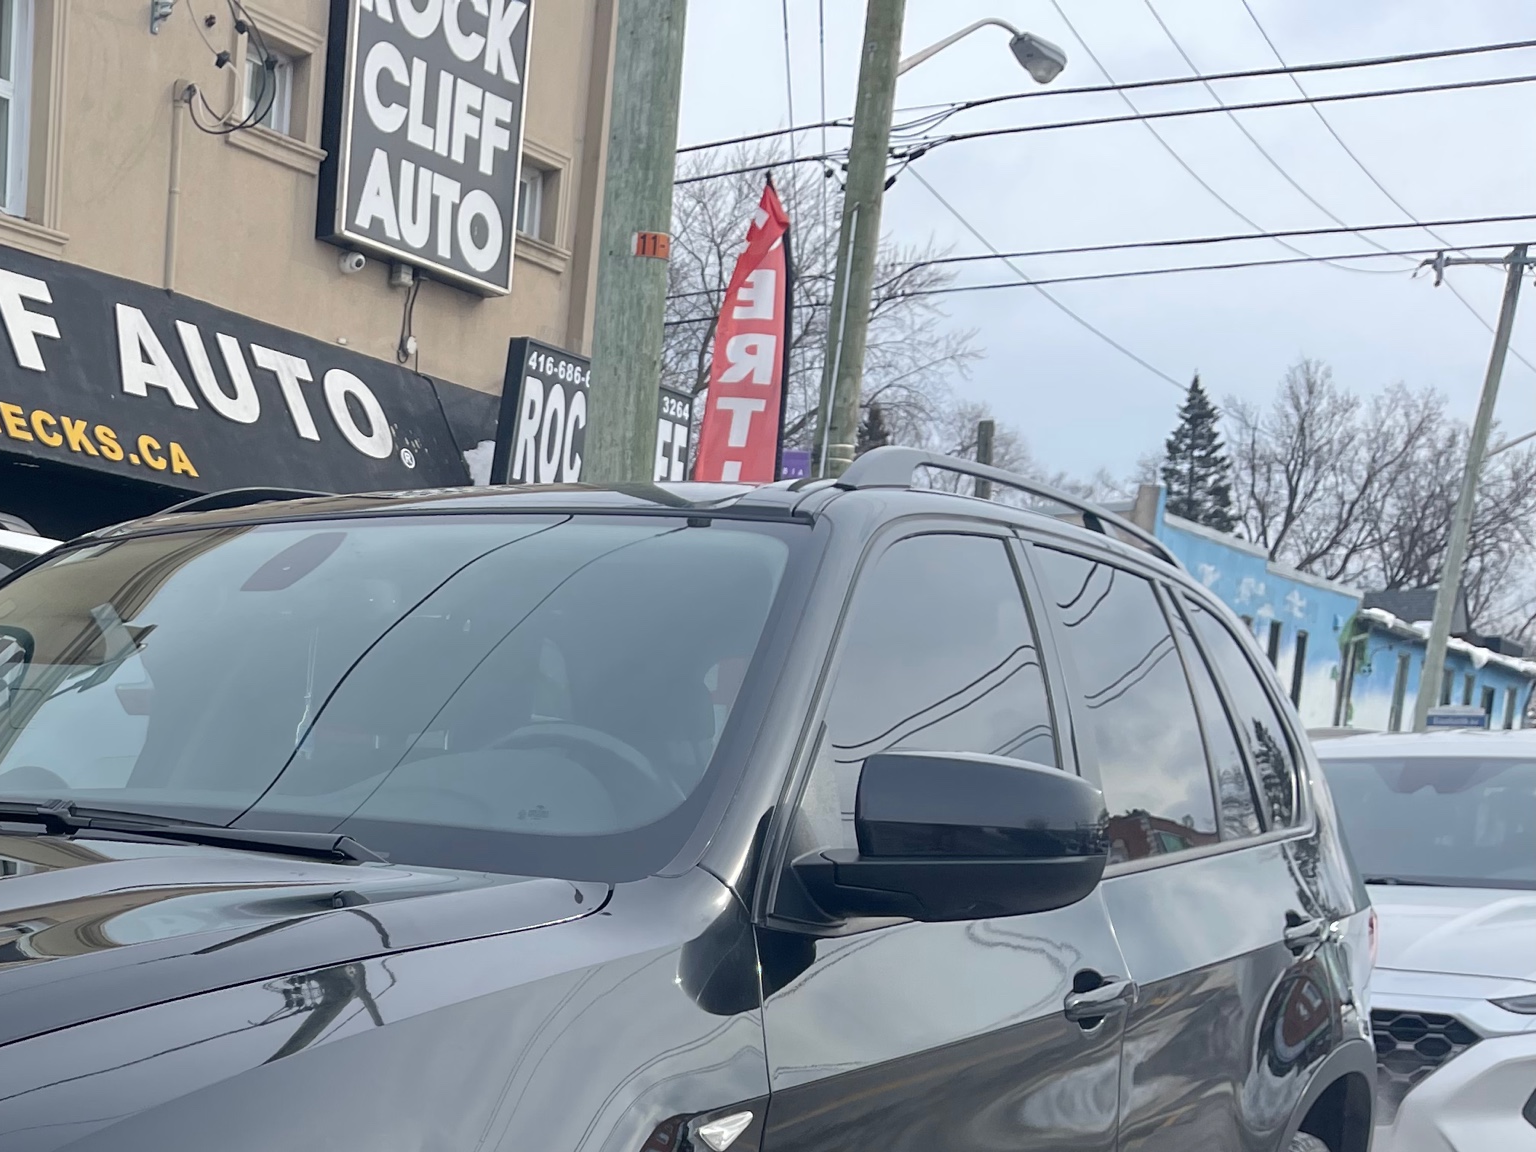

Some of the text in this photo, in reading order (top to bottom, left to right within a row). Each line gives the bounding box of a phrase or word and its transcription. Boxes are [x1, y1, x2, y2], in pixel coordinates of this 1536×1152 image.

[361, 0, 527, 84] CK
[363, 41, 513, 176] CLIFF
[355, 148, 503, 273] AUTO
[115, 302, 395, 460] AUTO
